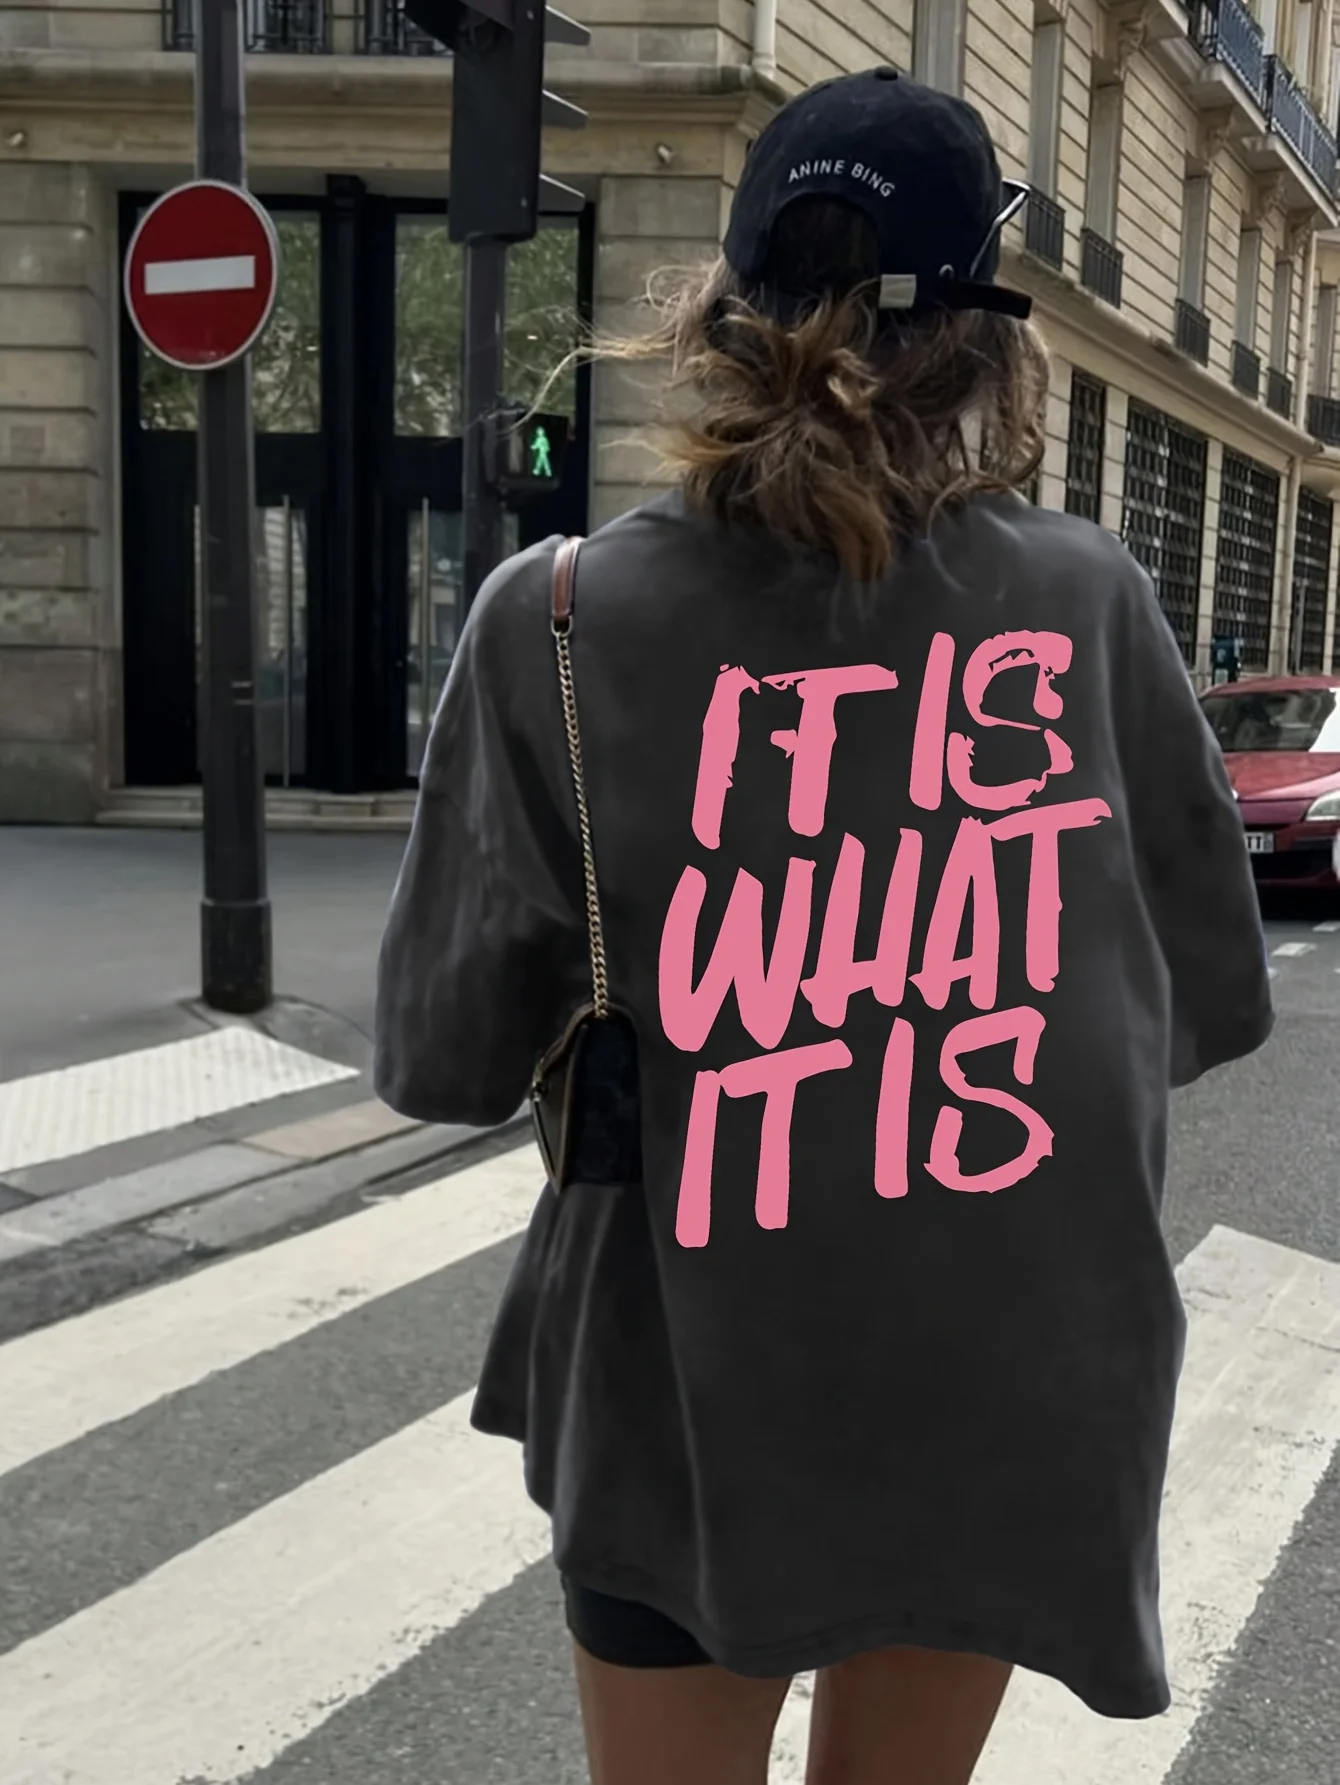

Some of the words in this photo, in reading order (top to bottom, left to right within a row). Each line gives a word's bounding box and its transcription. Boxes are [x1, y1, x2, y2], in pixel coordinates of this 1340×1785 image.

[788, 159, 845, 184] ANINE
[850, 162, 895, 197] BING
[691, 664, 899, 850] IT
[909, 630, 1074, 811] IS
[658, 798, 1112, 1052] WHAT
[675, 1038, 853, 1248] IT
[874, 1005, 1054, 1199] IS
